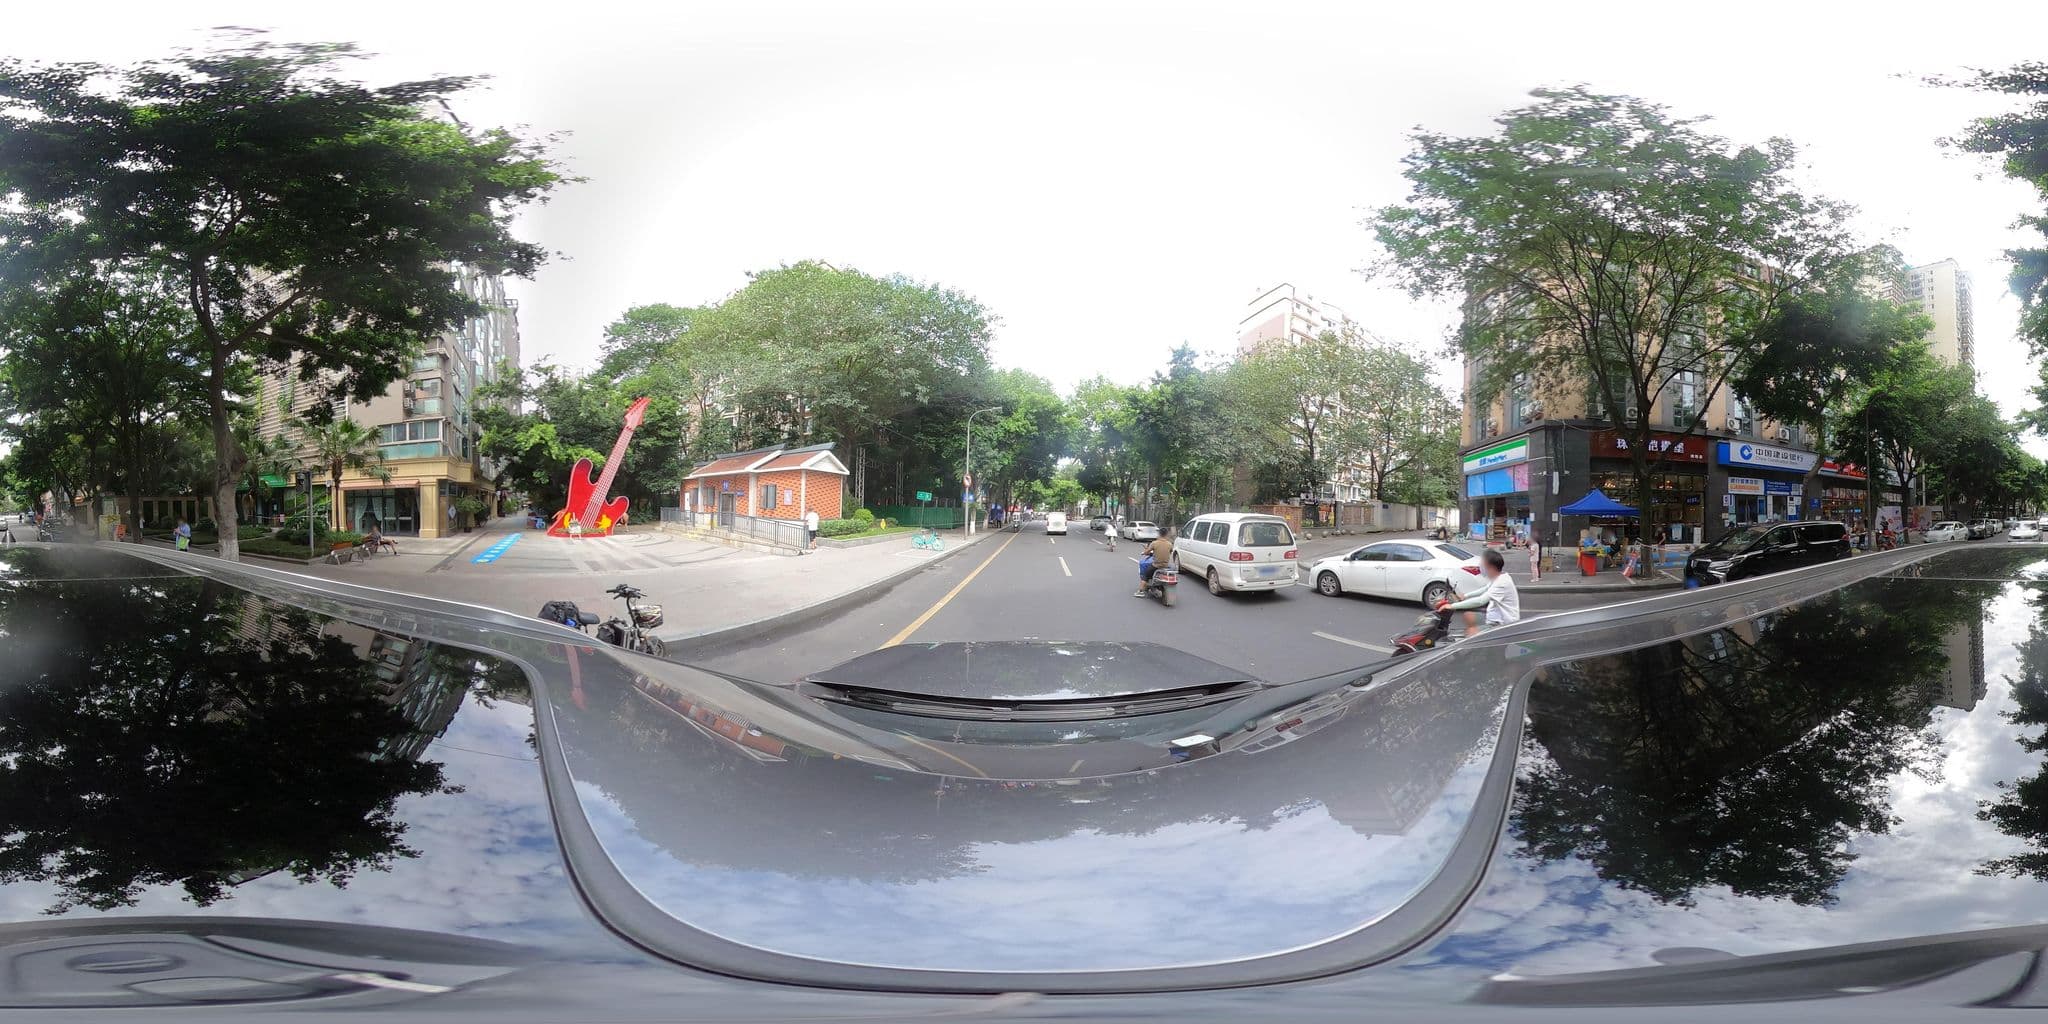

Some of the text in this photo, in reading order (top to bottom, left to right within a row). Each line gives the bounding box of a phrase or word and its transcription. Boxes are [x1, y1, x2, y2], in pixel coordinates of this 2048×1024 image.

[1755, 448, 1804, 462] 中国建设银行
